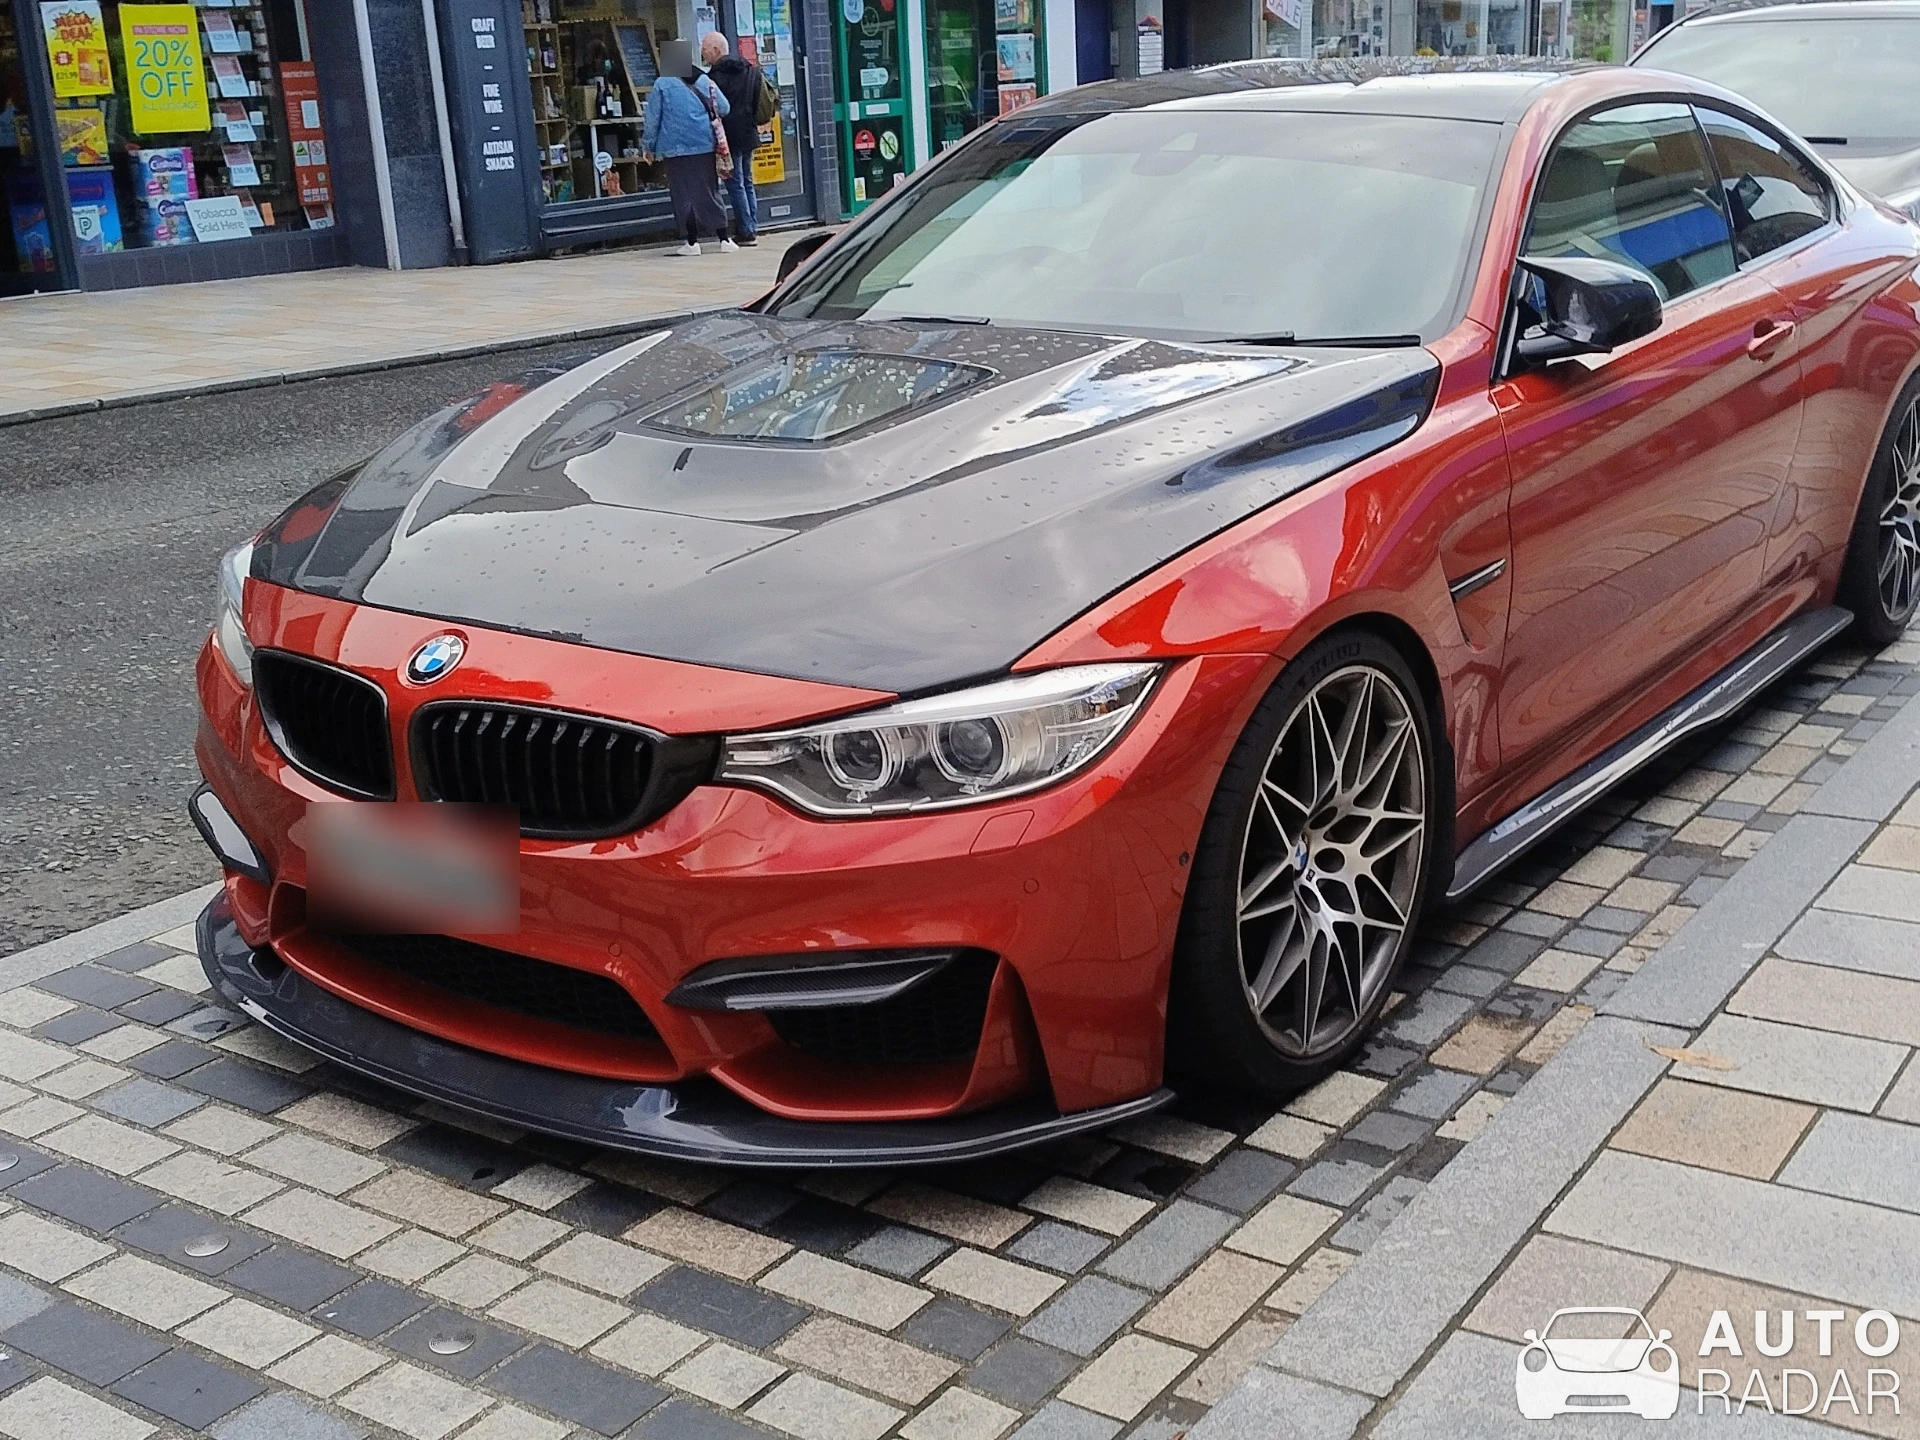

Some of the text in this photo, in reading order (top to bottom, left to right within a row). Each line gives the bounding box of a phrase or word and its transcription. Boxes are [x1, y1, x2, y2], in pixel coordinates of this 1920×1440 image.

[471, 18, 495, 32] CRAFT
[135, 40, 193, 67] 20%
[140, 71, 194, 98] OFF
[482, 84, 500, 97] FINE
[483, 100, 503, 113] WINE
[483, 140, 514, 155] ARTISAN
[485, 156, 514, 171] SNACKS
[194, 208, 237, 219] Tobacco
[197, 221, 245, 233] Sold Here
